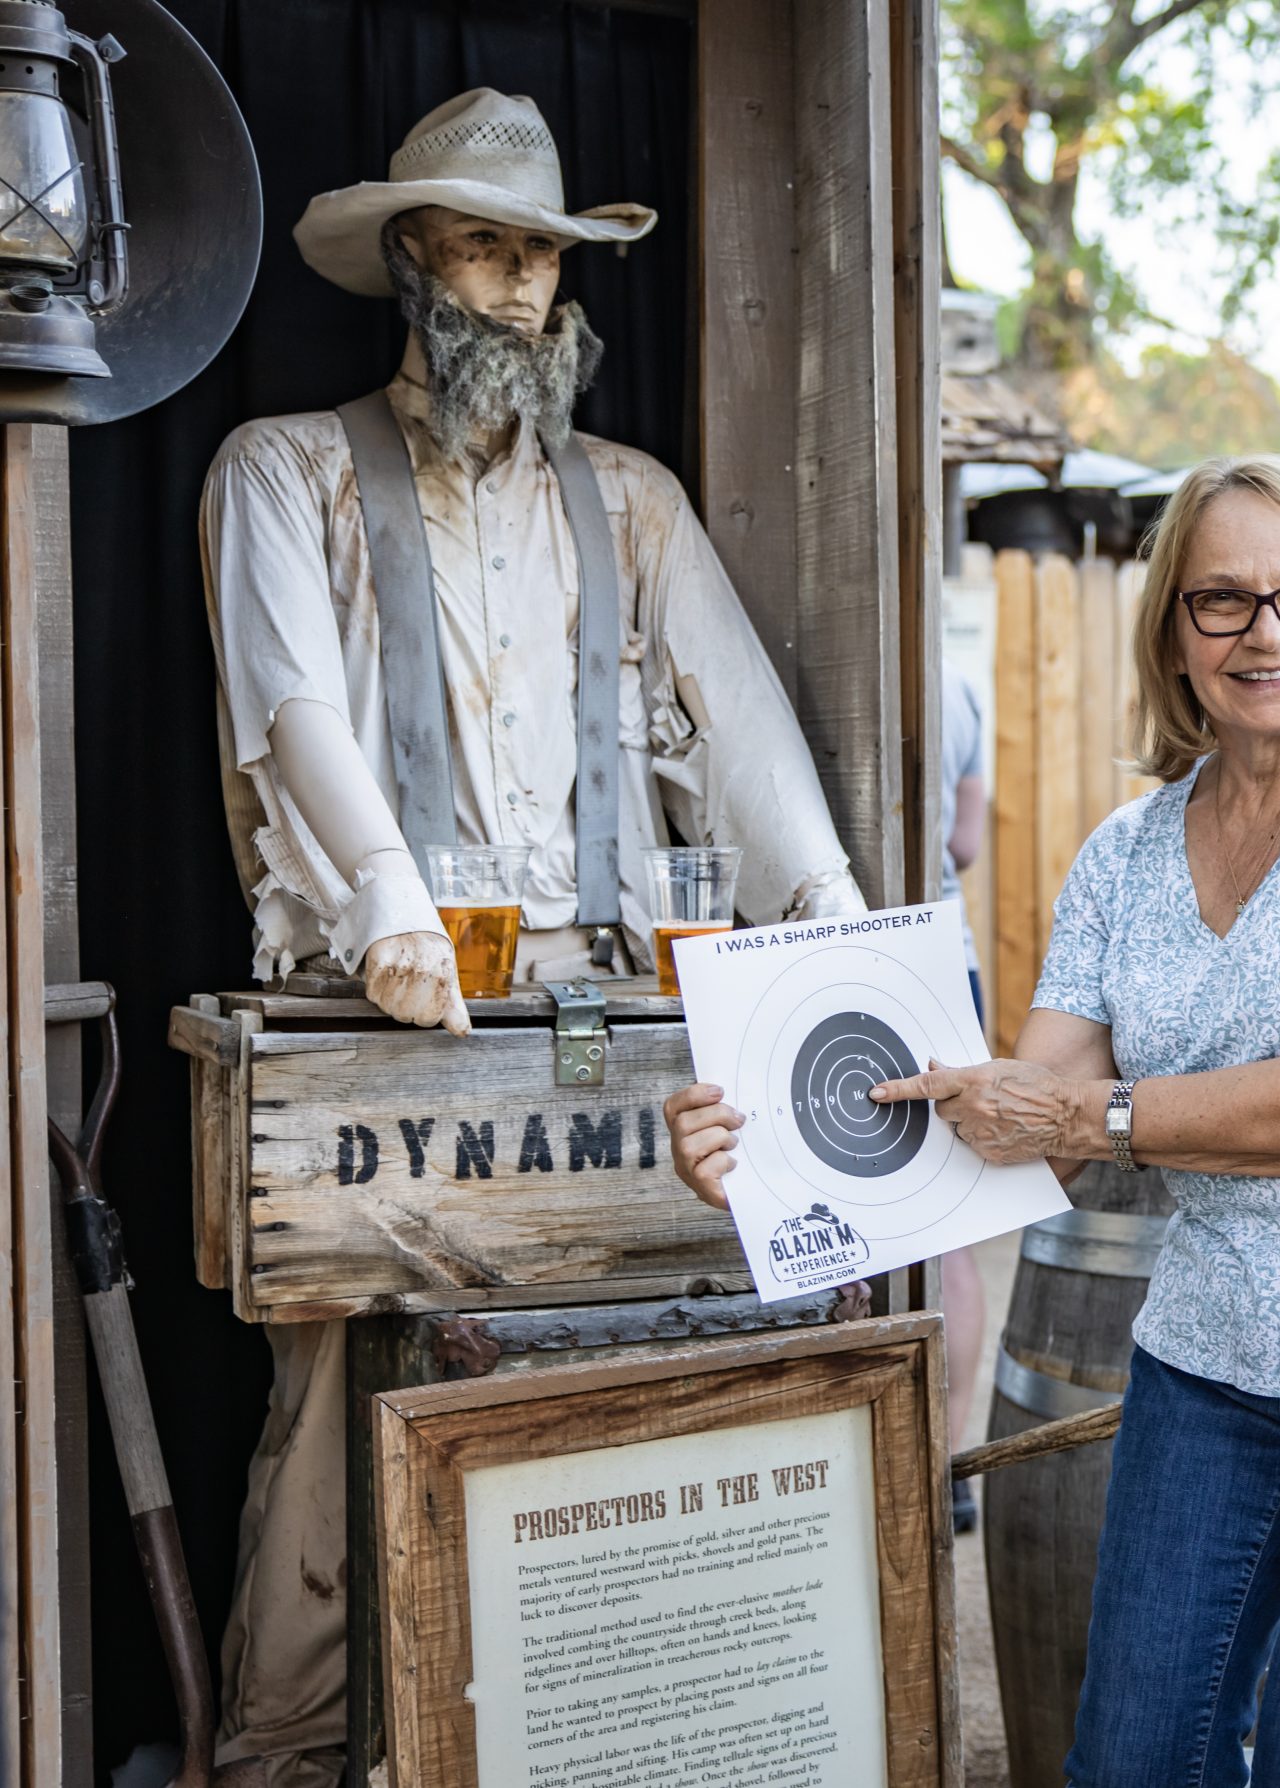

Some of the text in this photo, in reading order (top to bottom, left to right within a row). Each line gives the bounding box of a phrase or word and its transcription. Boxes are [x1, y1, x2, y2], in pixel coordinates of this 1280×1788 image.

[716, 912, 933, 954] I WAS A SHARP SHOOTER AT
[751, 1111, 757, 1121] 5
[776, 1105, 783, 1116] 6
[796, 1101, 802, 1112] 7
[813, 1099, 821, 1108] 8
[828, 1095, 835, 1105] 9
[782, 1217, 804, 1232] THE
[791, 1251, 849, 1274] EXPERIENCE
[797, 1268, 856, 1288] BLAZINM.COM
[513, 1460, 829, 1543] PROSPECTORS IN THE WEST
[517, 1511, 831, 1576] Prospectors, lured by the promise of gold, silver and other precious
[518, 1525, 824, 1591] metals ventured westward with picks, shovels and gold pans. The
[519, 1541, 829, 1607] majority of early prospectors had no training and relied mainly on
[520, 1591, 643, 1622] luck to discover deposits.
[521, 1578, 824, 1648] The traditional method used to find the ever-elusive lode
[522, 1645, 565, 1664] involved
[613, 1634, 629, 1646] the
[630, 1622, 687, 1642] countryside
[689, 1613, 727, 1631] through
[728, 1608, 754, 1622] creek
[755, 1604, 780, 1617] beds,
[780, 1600, 807, 1612] along
[523, 1612, 818, 1679] ridgelines and over hilltops, often on hands and knees, looking
[524, 1633, 793, 1694] for signs of mineralization in treacherous rocky outcrops.
[525, 1648, 825, 1720] Prior to taking any samples, a prospector had to claim to the
[526, 1663, 829, 1736] land he wanted to prospect by placing posts and signs on all four
[527, 1699, 737, 1751] corners of the area and registering his claim.
[528, 1701, 825, 1777] Heavy physical labor was the life of the prospector, digging and
[572, 1714, 830, 1786] panning and sifting. His camp was often set up on hard
